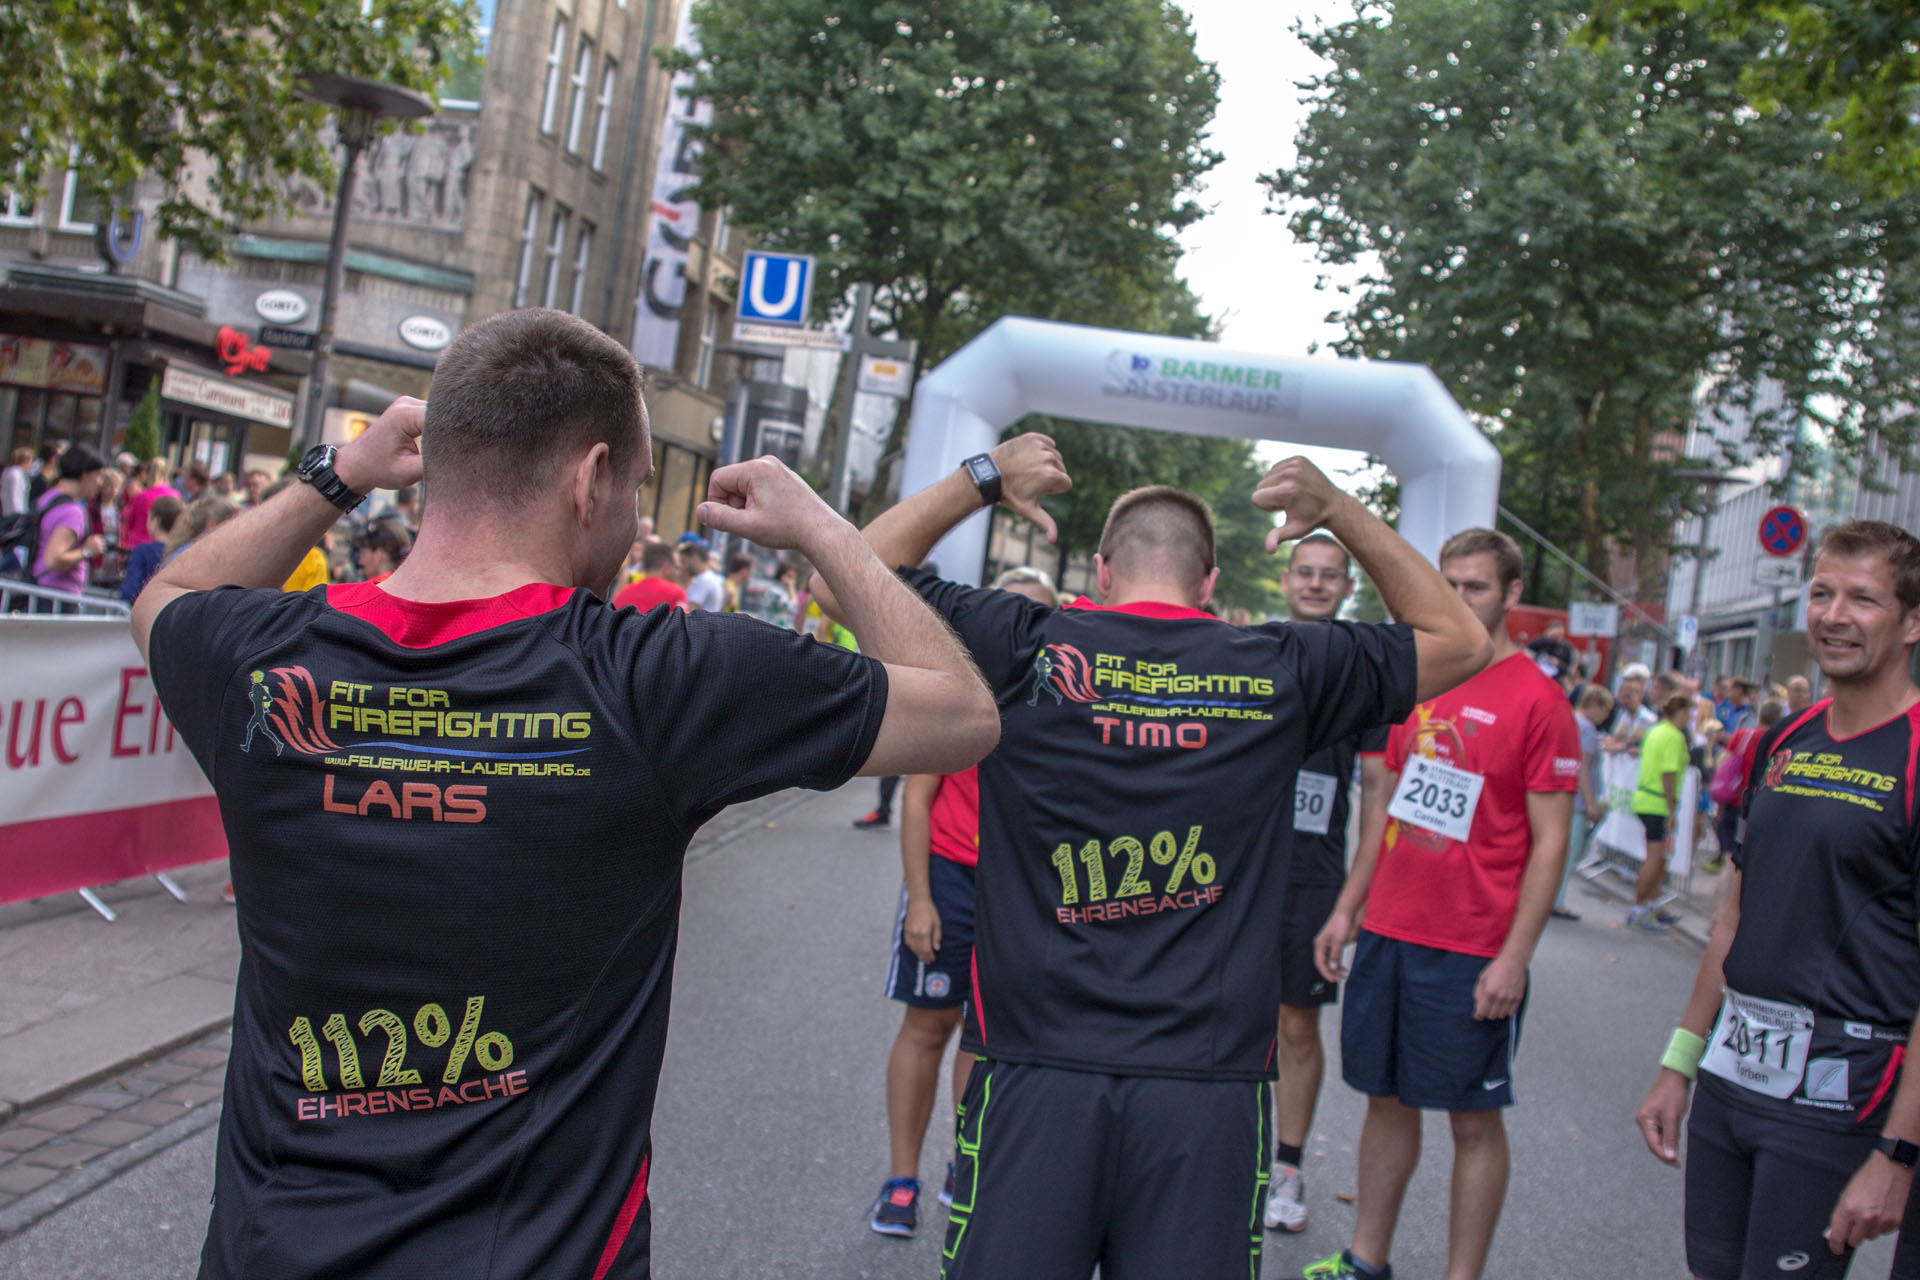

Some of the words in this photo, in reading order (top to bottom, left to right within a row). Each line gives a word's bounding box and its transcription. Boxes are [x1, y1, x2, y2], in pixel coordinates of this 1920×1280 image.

[751, 257, 801, 317] U
[1160, 357, 1283, 391] BARMER
[1124, 378, 1278, 413] ALSTERLAUF
[1094, 668, 1274, 695] FIREFIGHTING
[1096, 653, 1126, 669] FIT
[1136, 660, 1177, 676] FOR
[329, 680, 373, 703] FIT
[388, 687, 450, 708] FOR
[0, 696, 85, 771] ue
[329, 704, 591, 739] FIREFIGHTING
[1093, 716, 1208, 749] TIMO
[1792, 751, 1814, 763] FIT
[1815, 752, 1844, 766] FOR
[1784, 762, 1898, 792] FIREFIGHTING
[323, 773, 488, 823] LARS
[1404, 778, 1468, 819] 2033
[1052, 825, 1217, 905] 112%
[1056, 885, 1224, 924] EHRENSACHE
[288, 996, 514, 1092] 112%
[1722, 1014, 1794, 1070] 2011
[1735, 1061, 1769, 1085] Torben
[298, 1069, 530, 1121] EHRENSACHE
